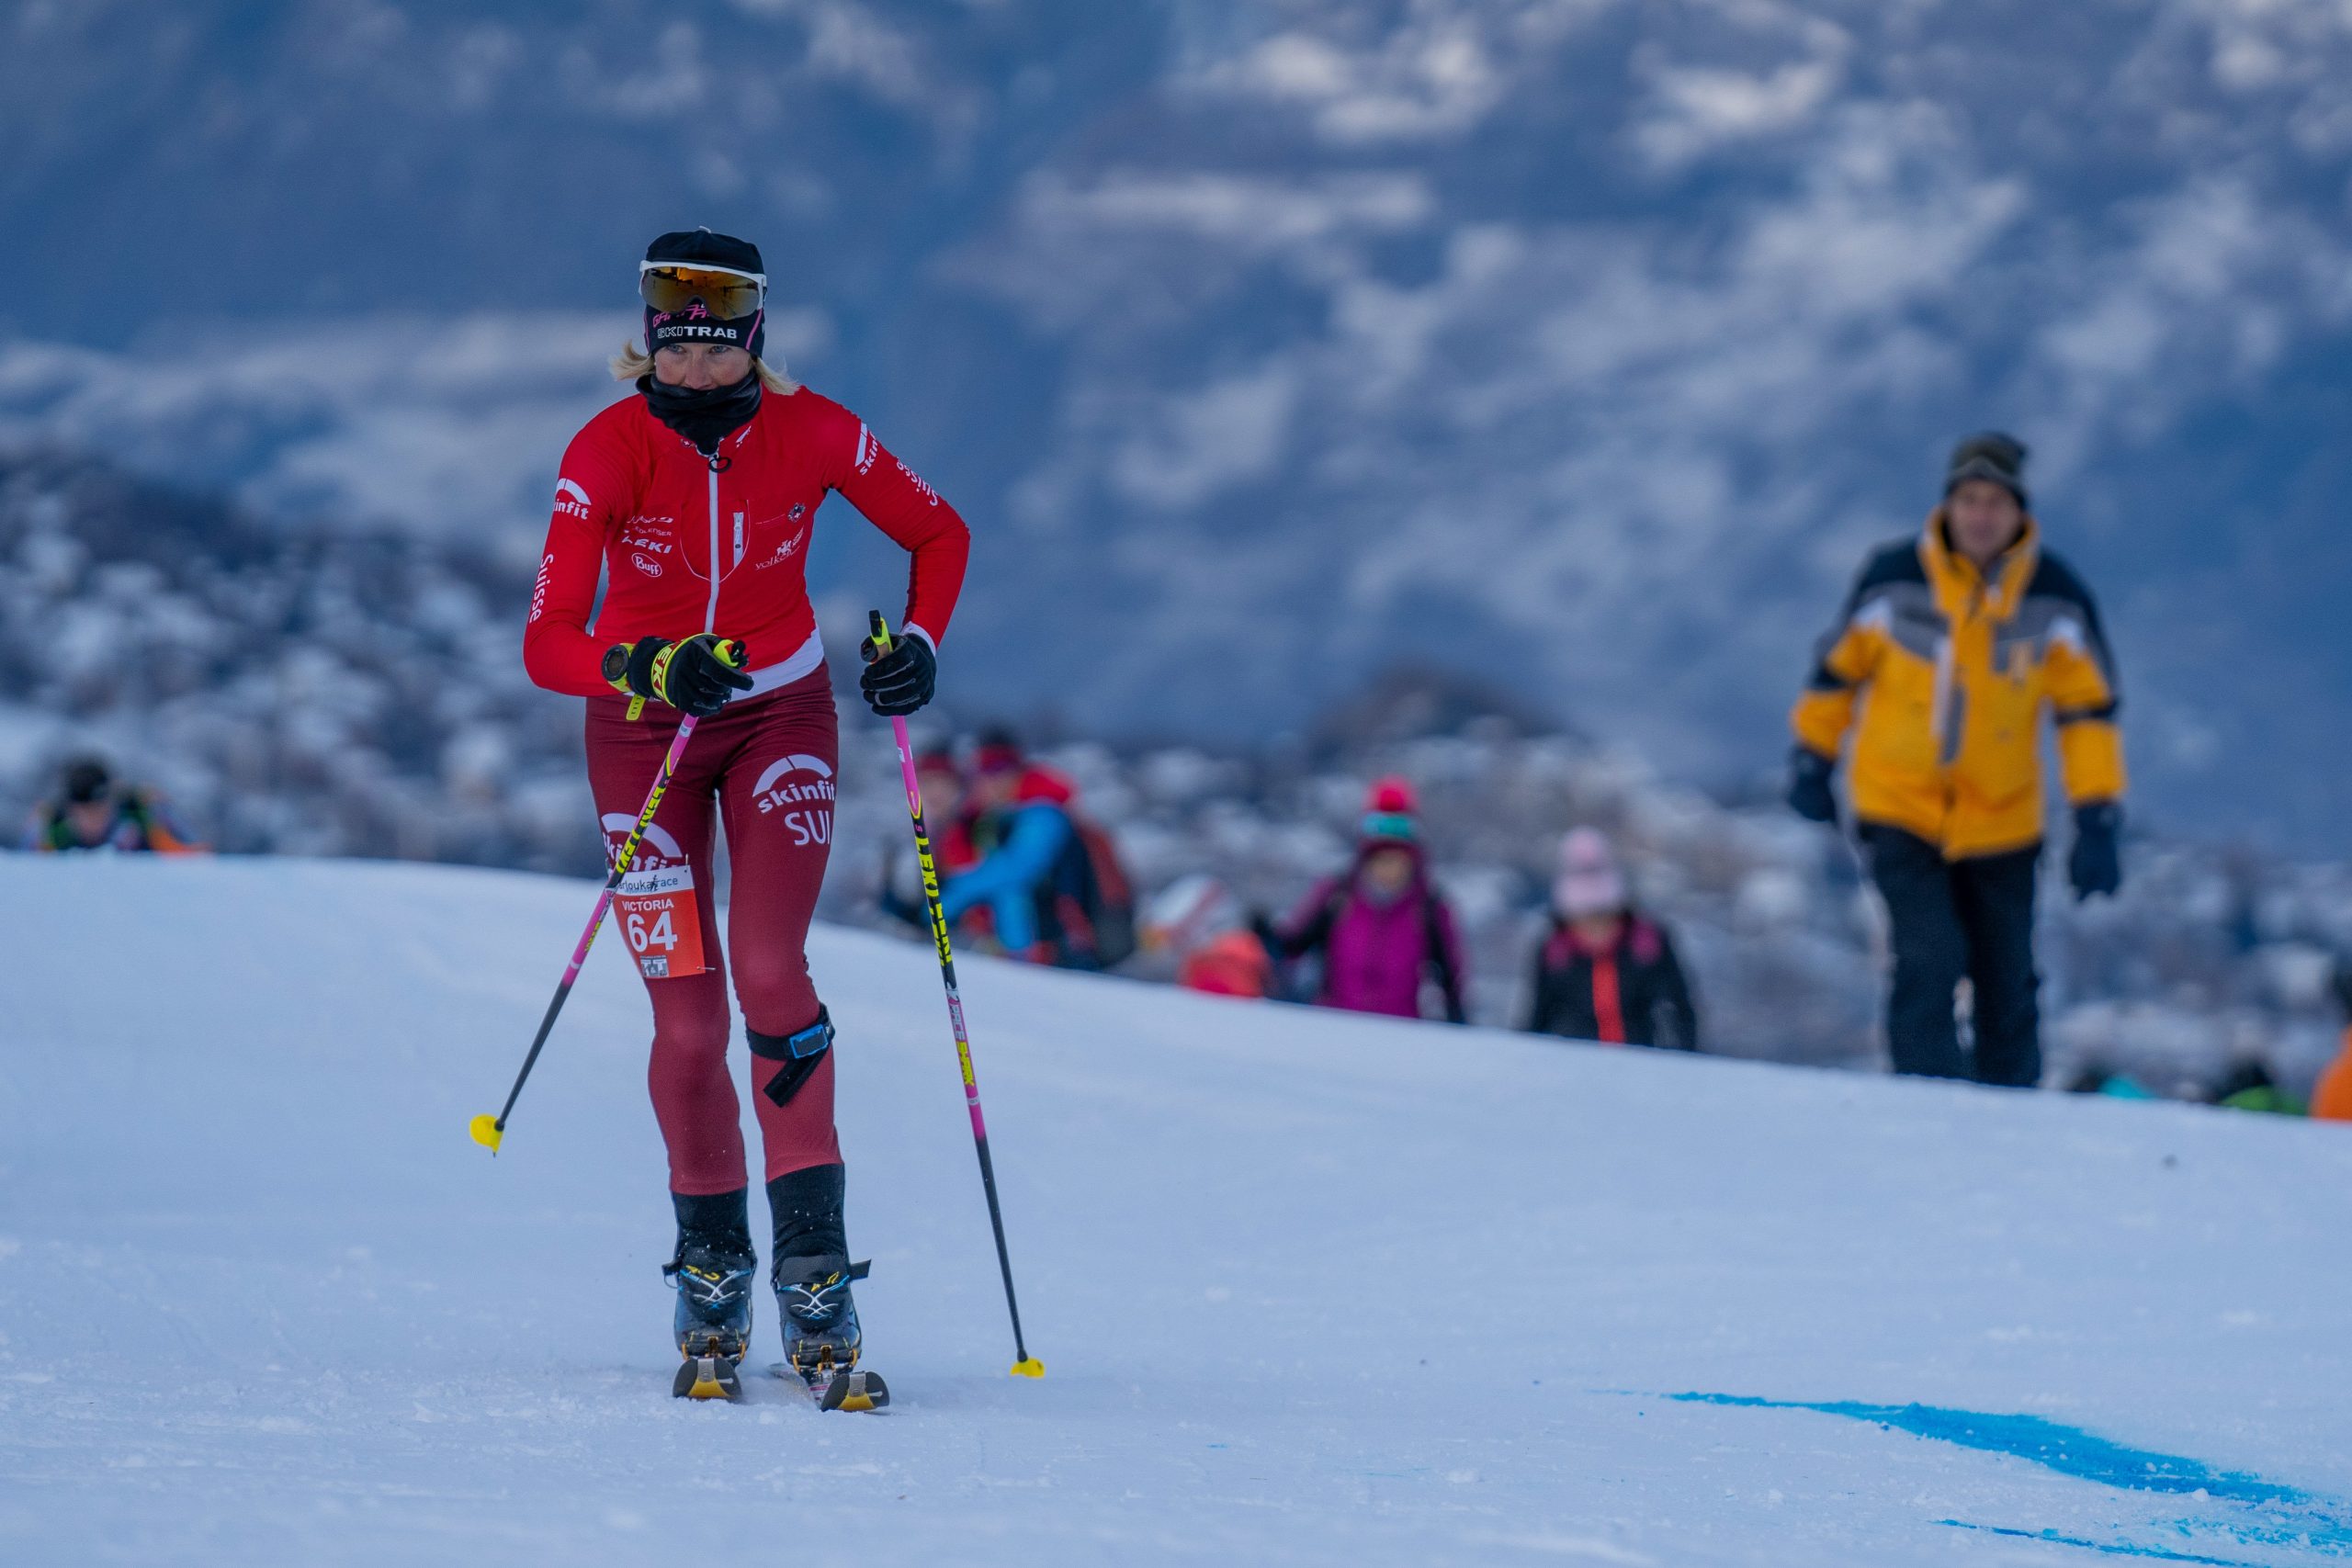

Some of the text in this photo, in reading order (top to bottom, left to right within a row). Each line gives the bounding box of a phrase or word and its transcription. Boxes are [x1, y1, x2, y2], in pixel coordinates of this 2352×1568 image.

[658, 326, 737, 339] SKITRAB
[635, 555, 659, 575] Buff
[529, 554, 554, 624] Suisse
[621, 898, 674, 912] VICTORIA
[627, 911, 678, 953] 64
